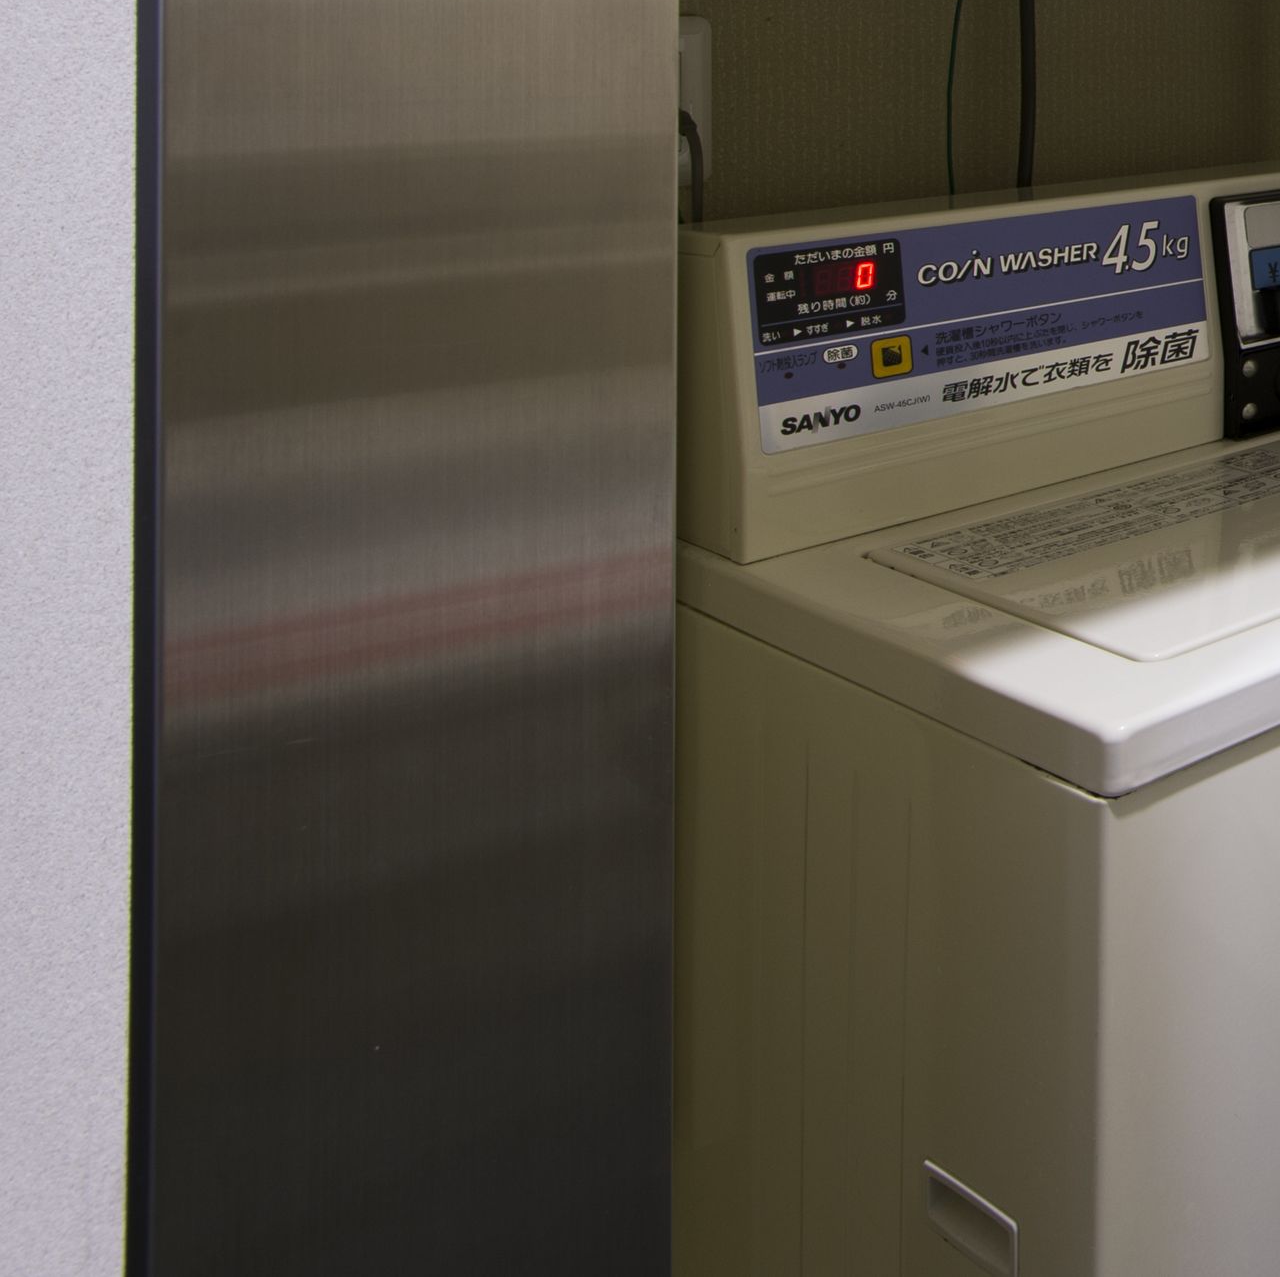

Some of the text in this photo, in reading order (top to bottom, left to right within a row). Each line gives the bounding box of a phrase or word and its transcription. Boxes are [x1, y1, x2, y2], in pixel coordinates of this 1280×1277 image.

[794, 242, 895, 265] ただいまの金額 円
[917, 249, 993, 286] COIN
[1000, 242, 1099, 273] WASHER
[1162, 234, 1190, 259] kg
[856, 262, 875, 289] 0
[766, 289, 796, 302] 運転中
[885, 290, 897, 302] 分
[806, 322, 829, 336] すすぎ
[861, 315, 882, 327] 脱水
[935, 312, 1062, 345] 洗濯槽シャワーボタン
[762, 331, 781, 343] 洗い
[827, 346, 855, 361] 除菌
[942, 328, 1199, 403] 電解水で衣類を 除菌
[781, 404, 861, 436] SANYO
